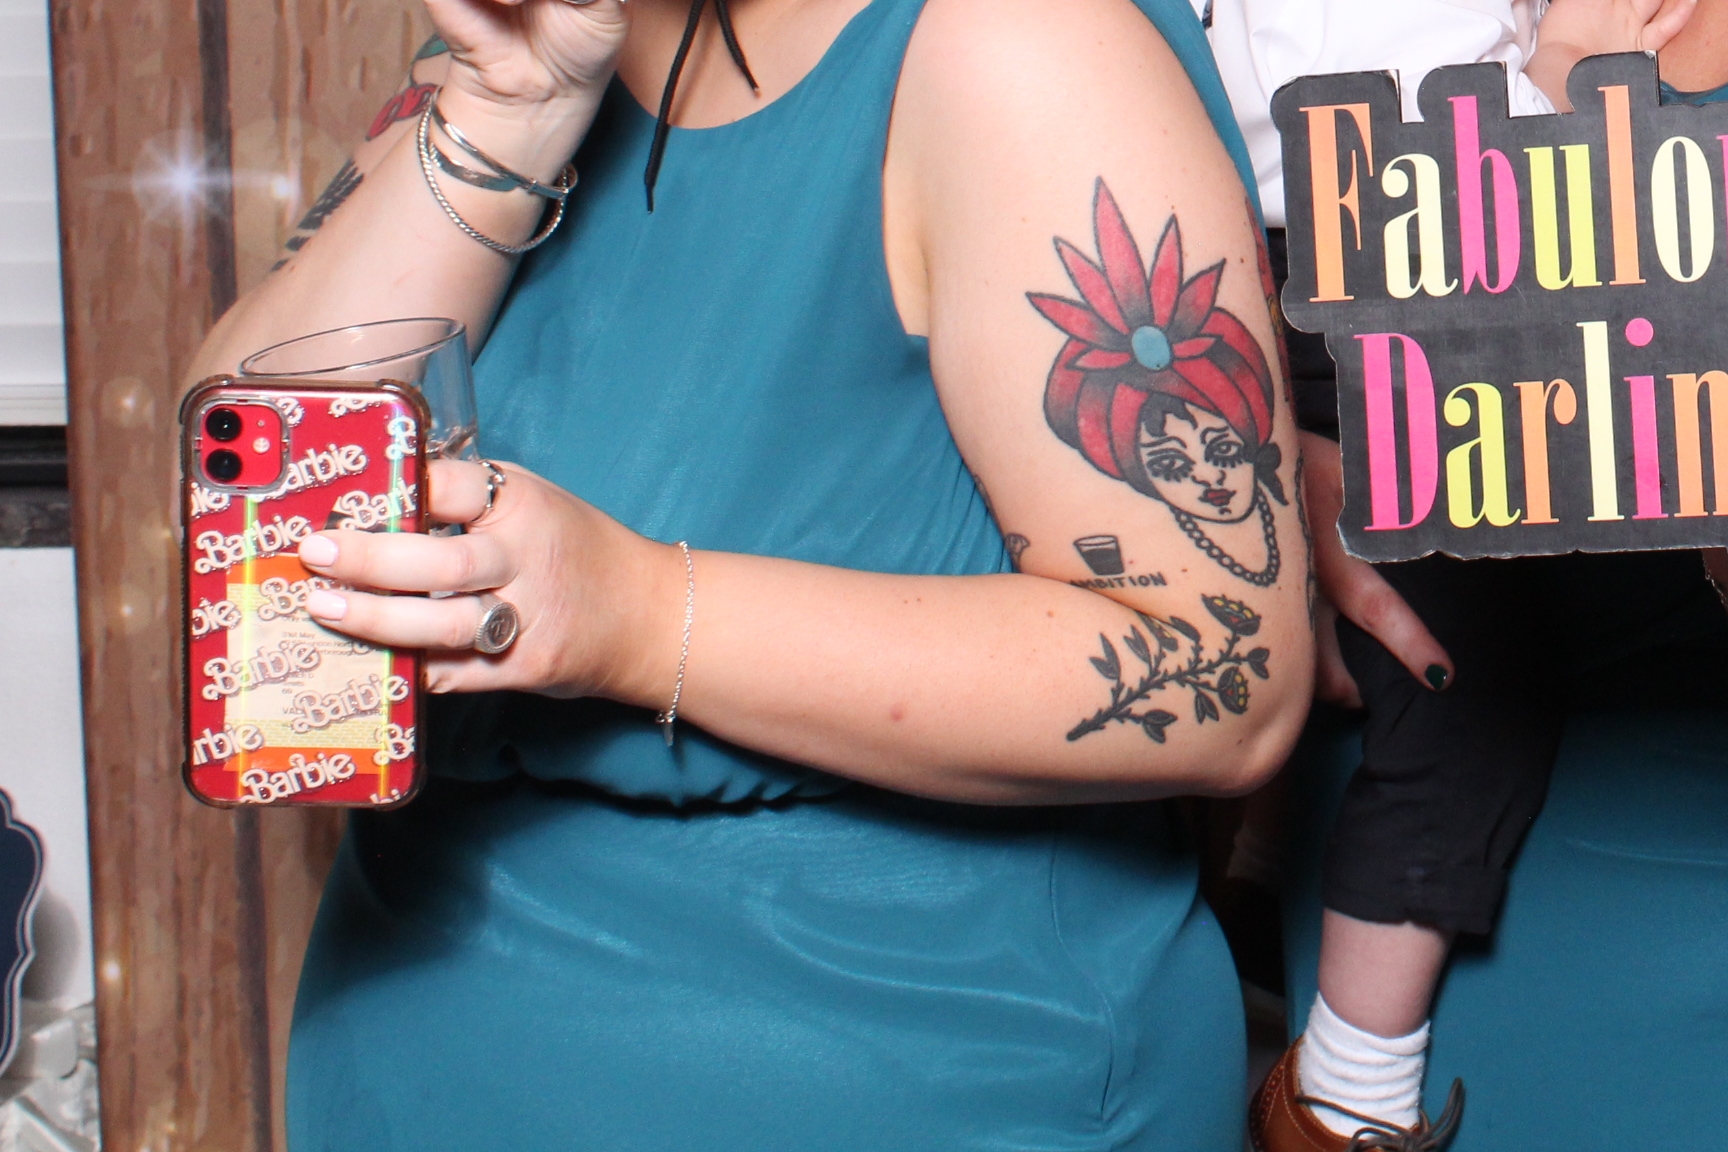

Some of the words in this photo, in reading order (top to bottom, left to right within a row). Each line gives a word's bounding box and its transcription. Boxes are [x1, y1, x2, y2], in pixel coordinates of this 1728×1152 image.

[195, 515, 313, 574] Barbie
[202, 640, 321, 700] Barbie
[293, 674, 409, 733] Barbie
[240, 753, 355, 804] Barbie
